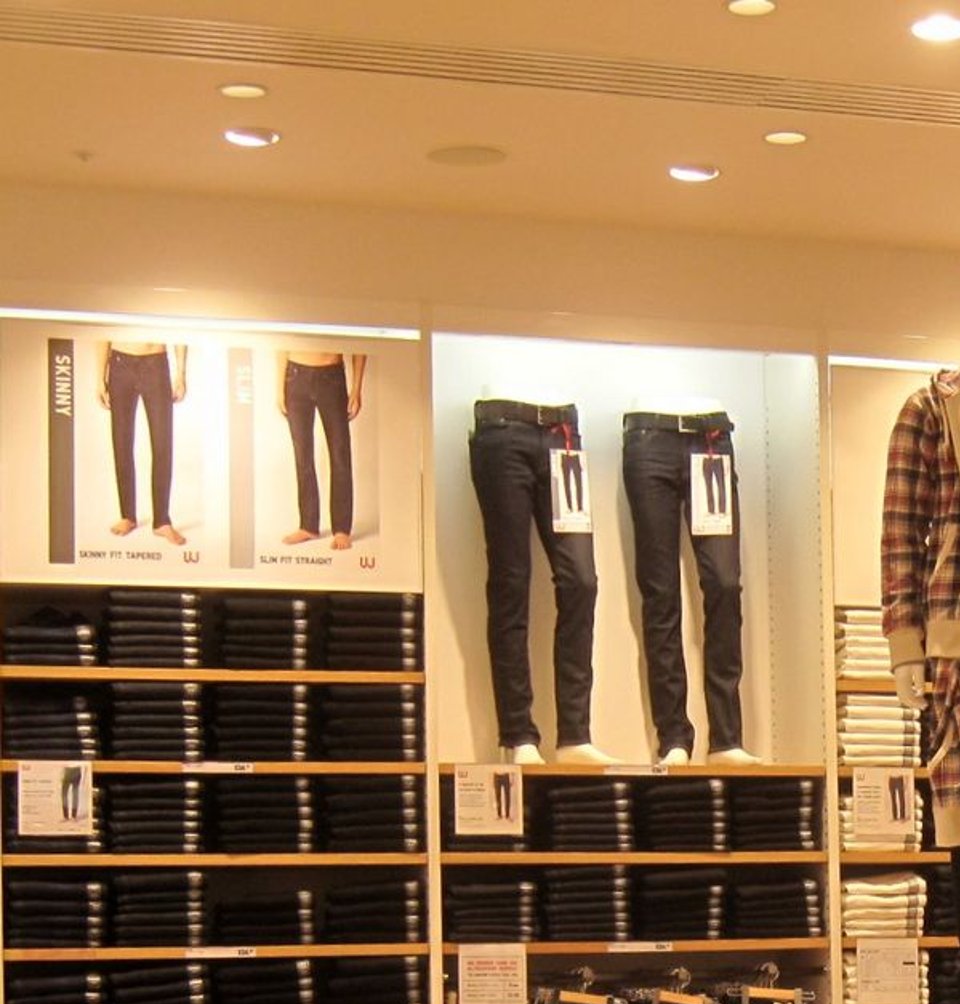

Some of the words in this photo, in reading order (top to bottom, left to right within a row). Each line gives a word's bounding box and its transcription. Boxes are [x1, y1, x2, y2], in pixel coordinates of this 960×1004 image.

[54, 354, 72, 417] SKINNY
[259, 555, 278, 564] SLIM
[280, 556, 293, 565] FIT
